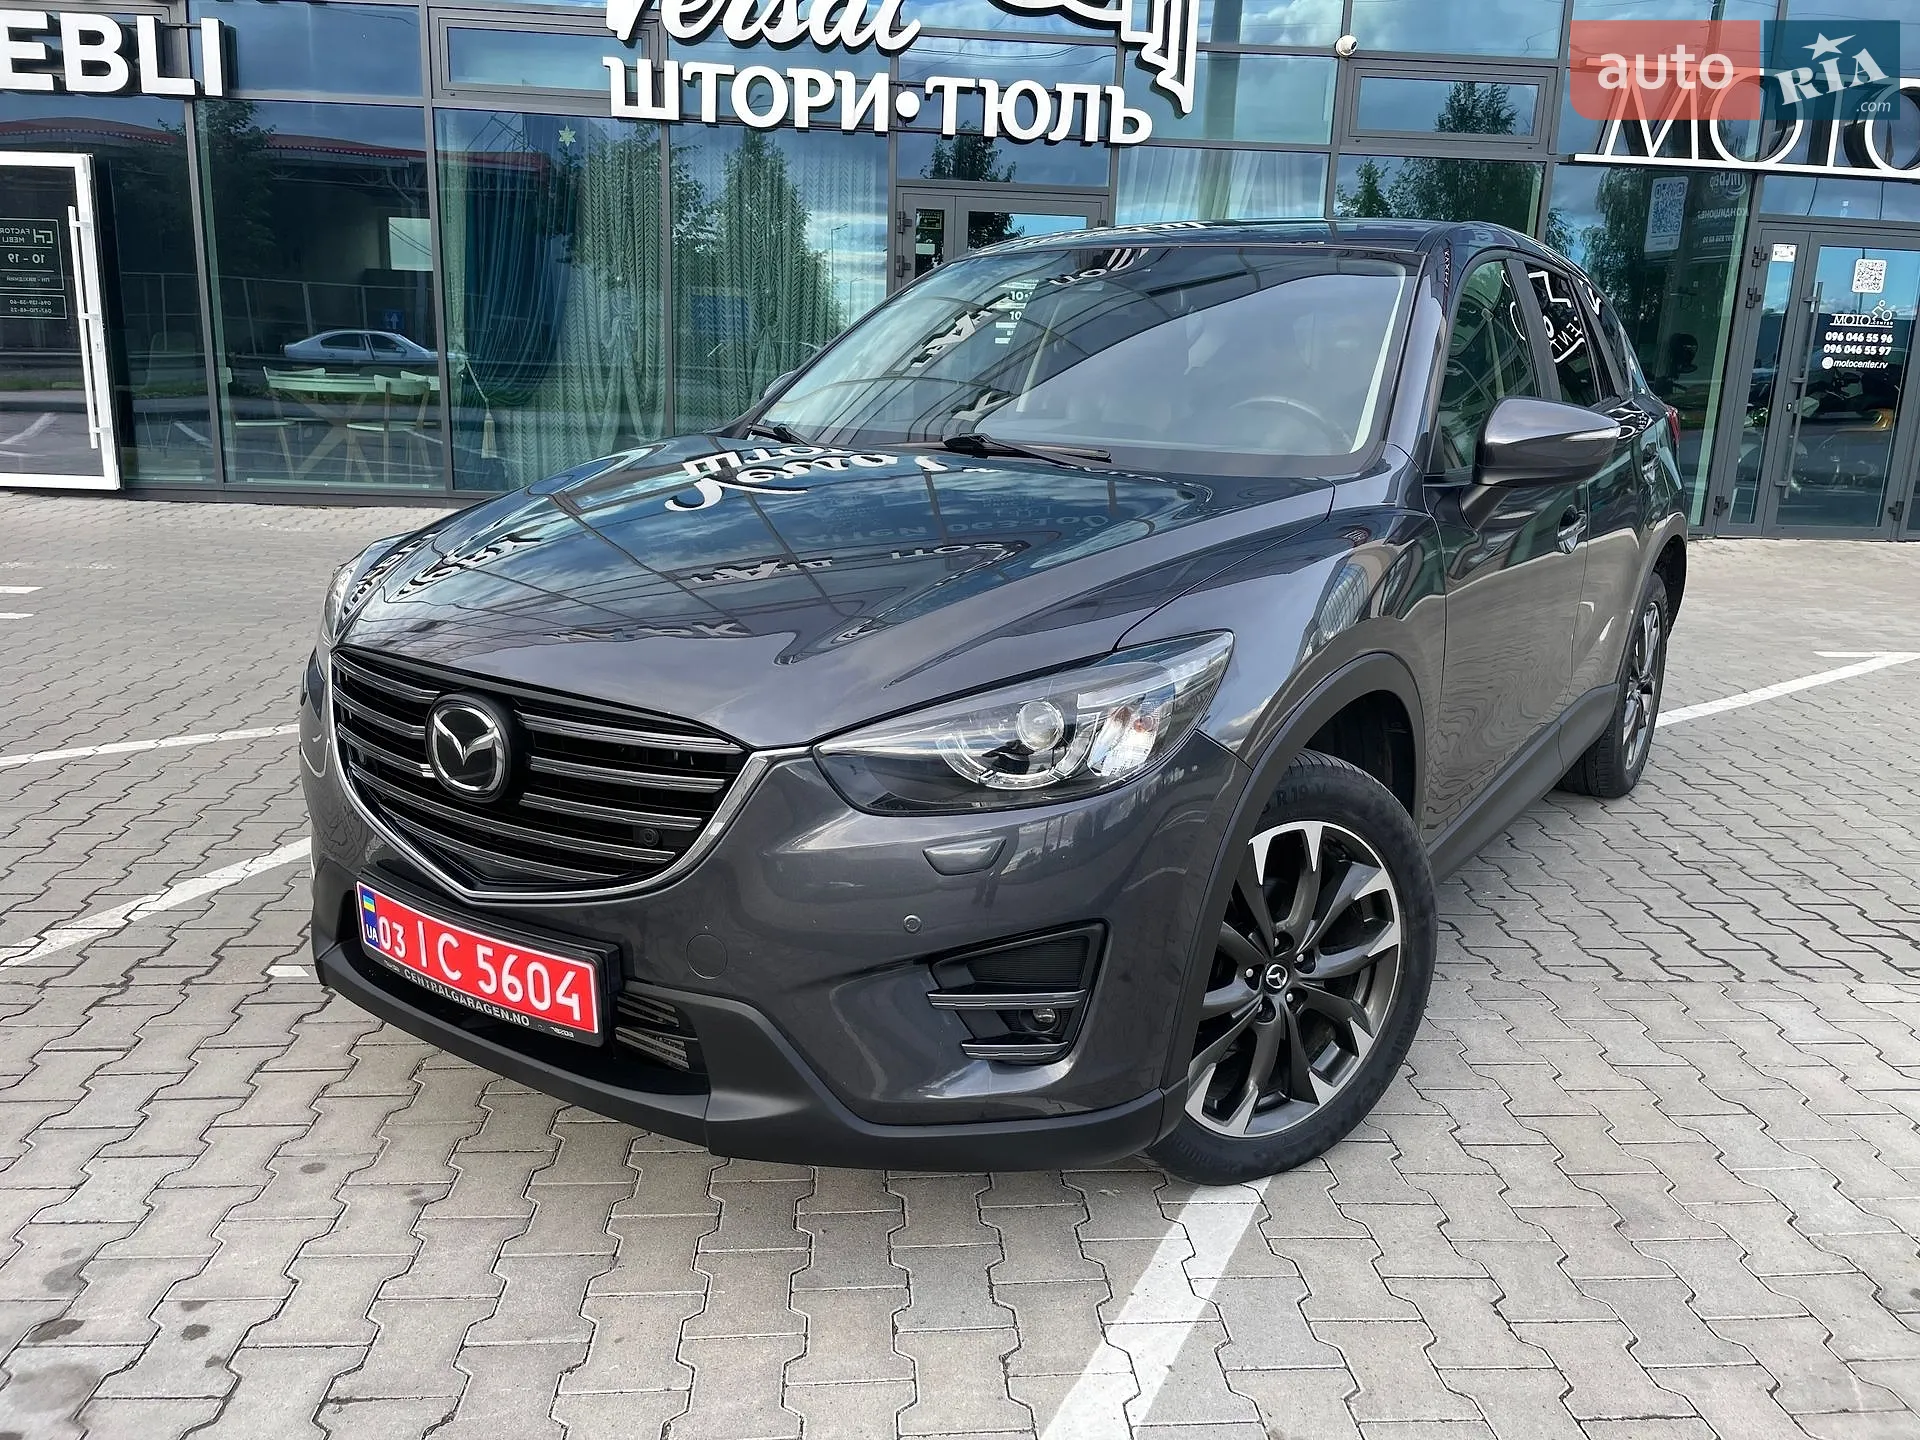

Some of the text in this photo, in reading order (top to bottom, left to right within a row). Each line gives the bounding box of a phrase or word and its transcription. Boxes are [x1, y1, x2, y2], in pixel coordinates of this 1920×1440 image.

[1830, 313, 1872, 327] MOTO
[1825, 331, 1893, 343] 096 046 55 96
[1823, 344, 1891, 356] 096 046 55 97
[1833, 359, 1888, 369] motocenter.rv
[366, 923, 379, 942] UA
[378, 915, 407, 959] 03
[476, 943, 581, 1021] 5604
[403, 968, 530, 1027] CENTRALGARAGEN.NO
